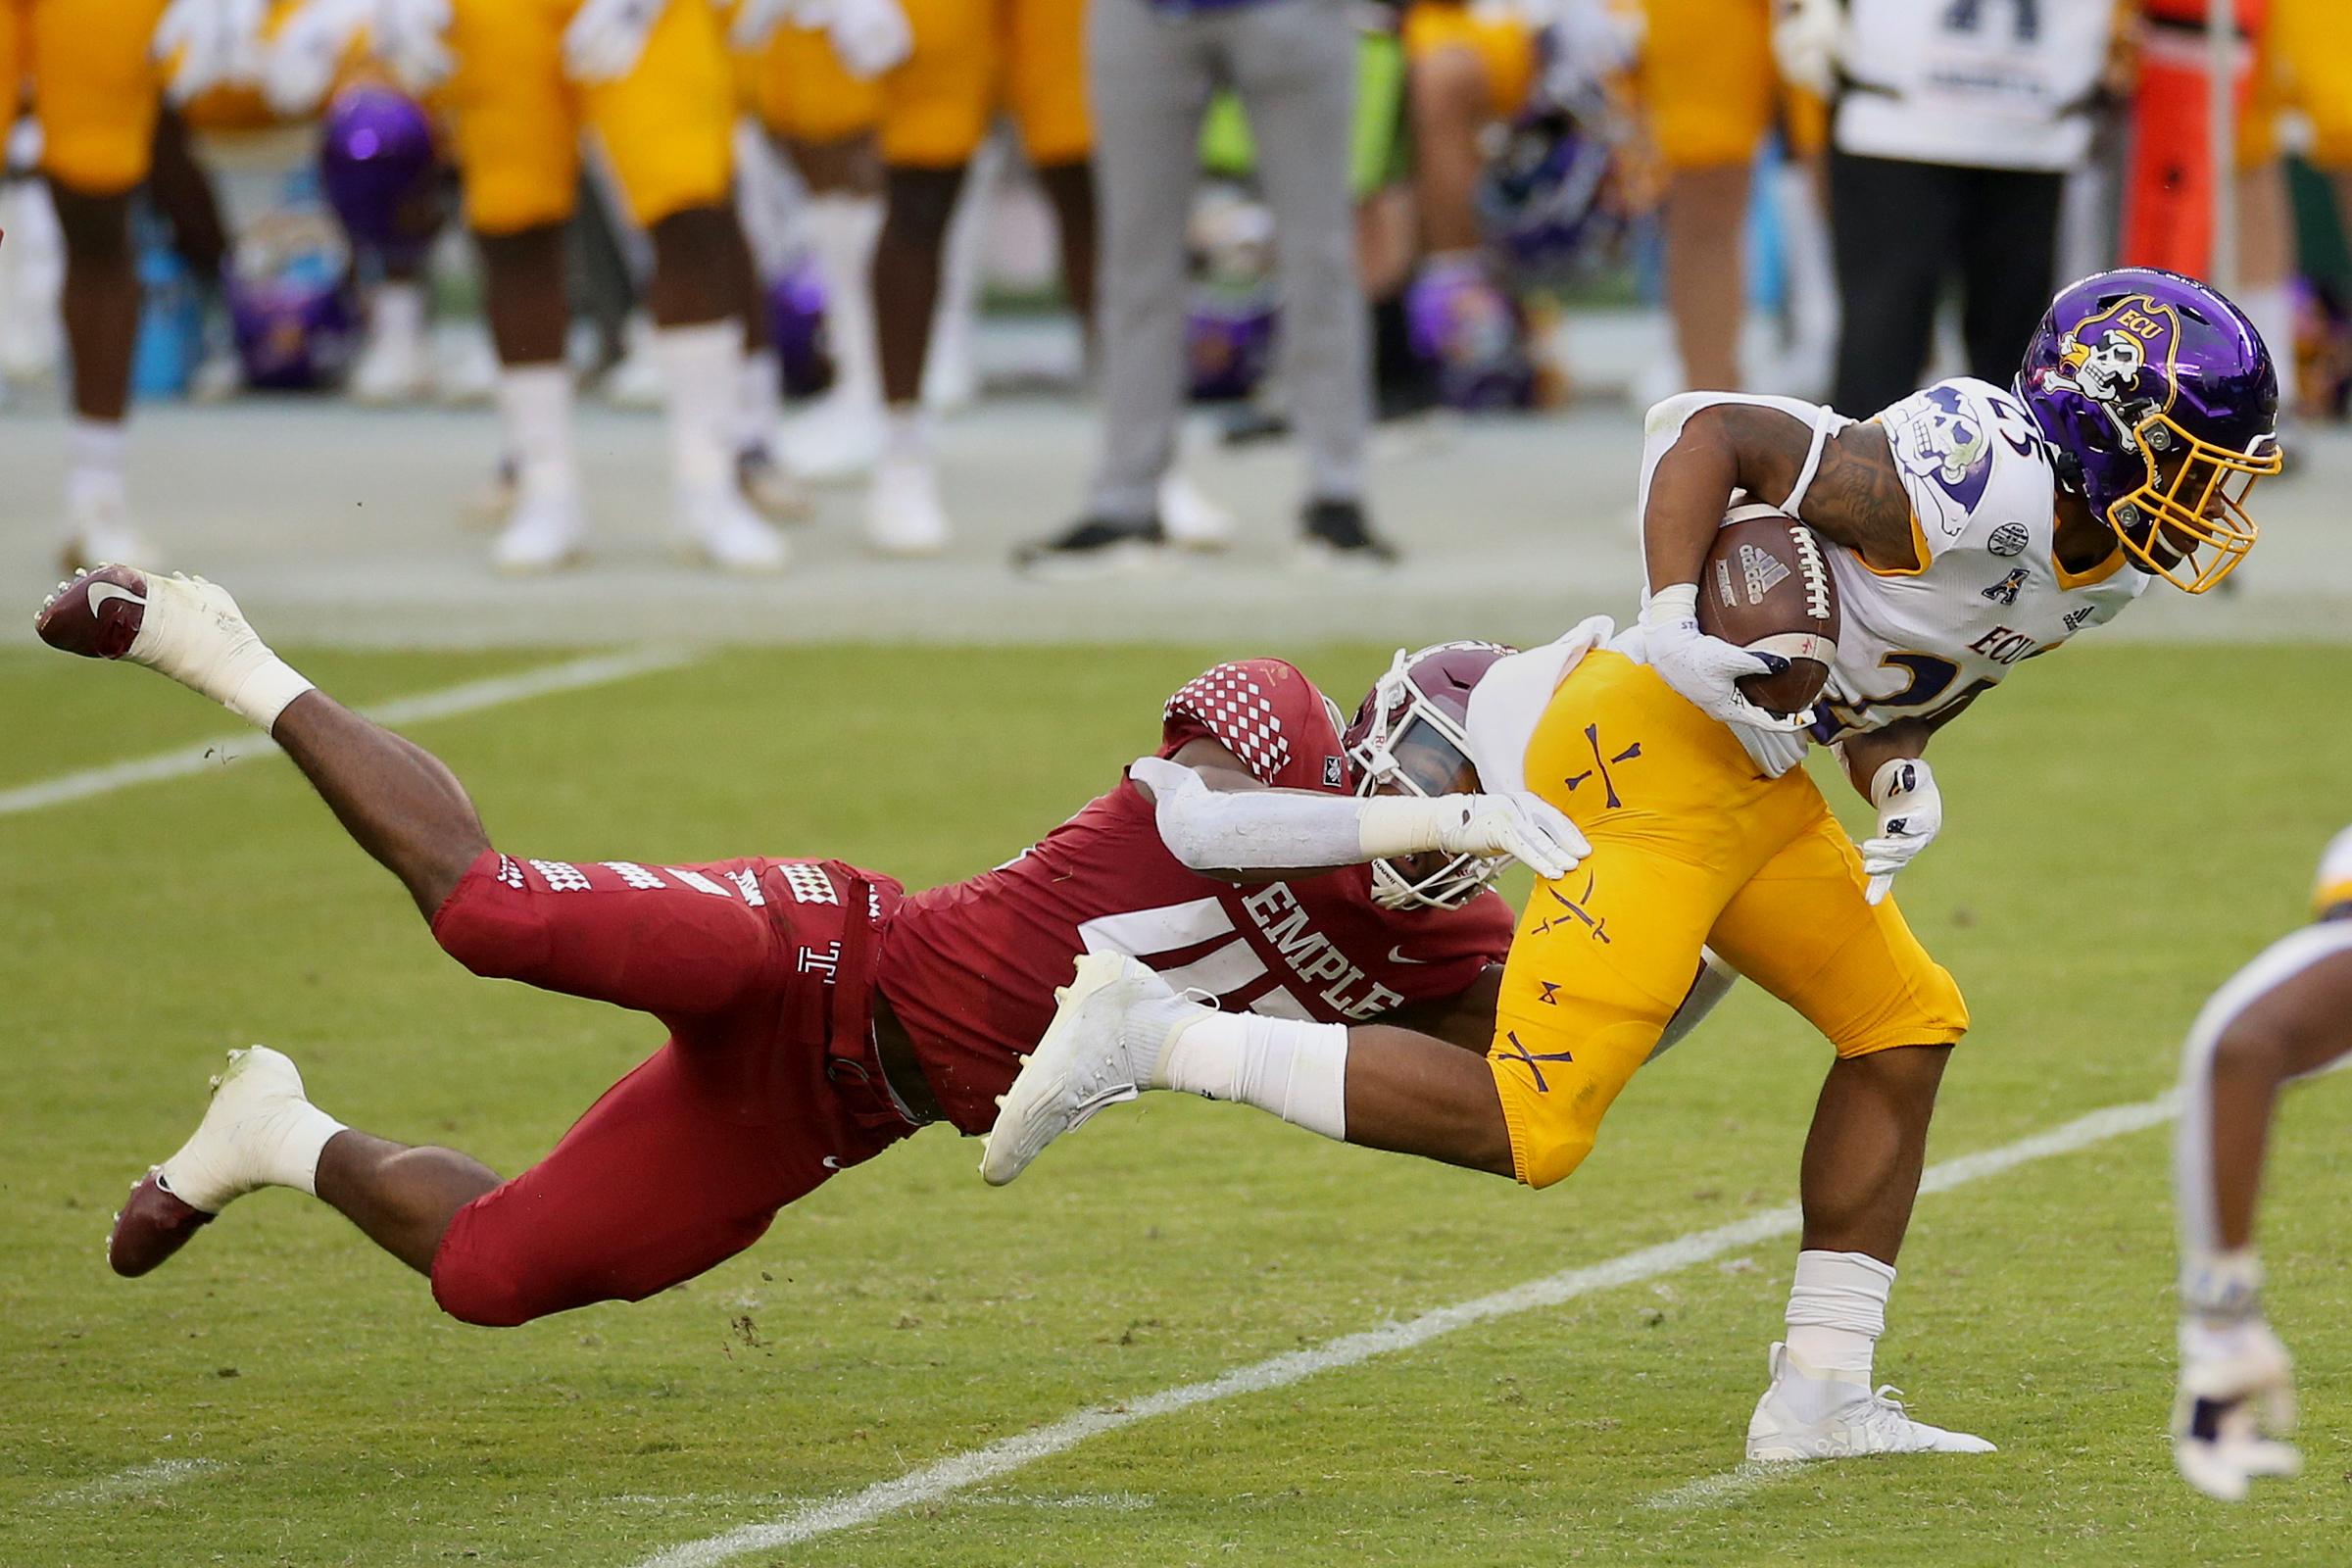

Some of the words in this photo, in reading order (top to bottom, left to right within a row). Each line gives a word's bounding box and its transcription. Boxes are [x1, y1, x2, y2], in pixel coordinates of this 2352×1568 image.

[2115, 308, 2165, 339] ECU
[1966, 625, 2038, 665] ECU
[1232, 881, 1404, 1020] EMPLE
